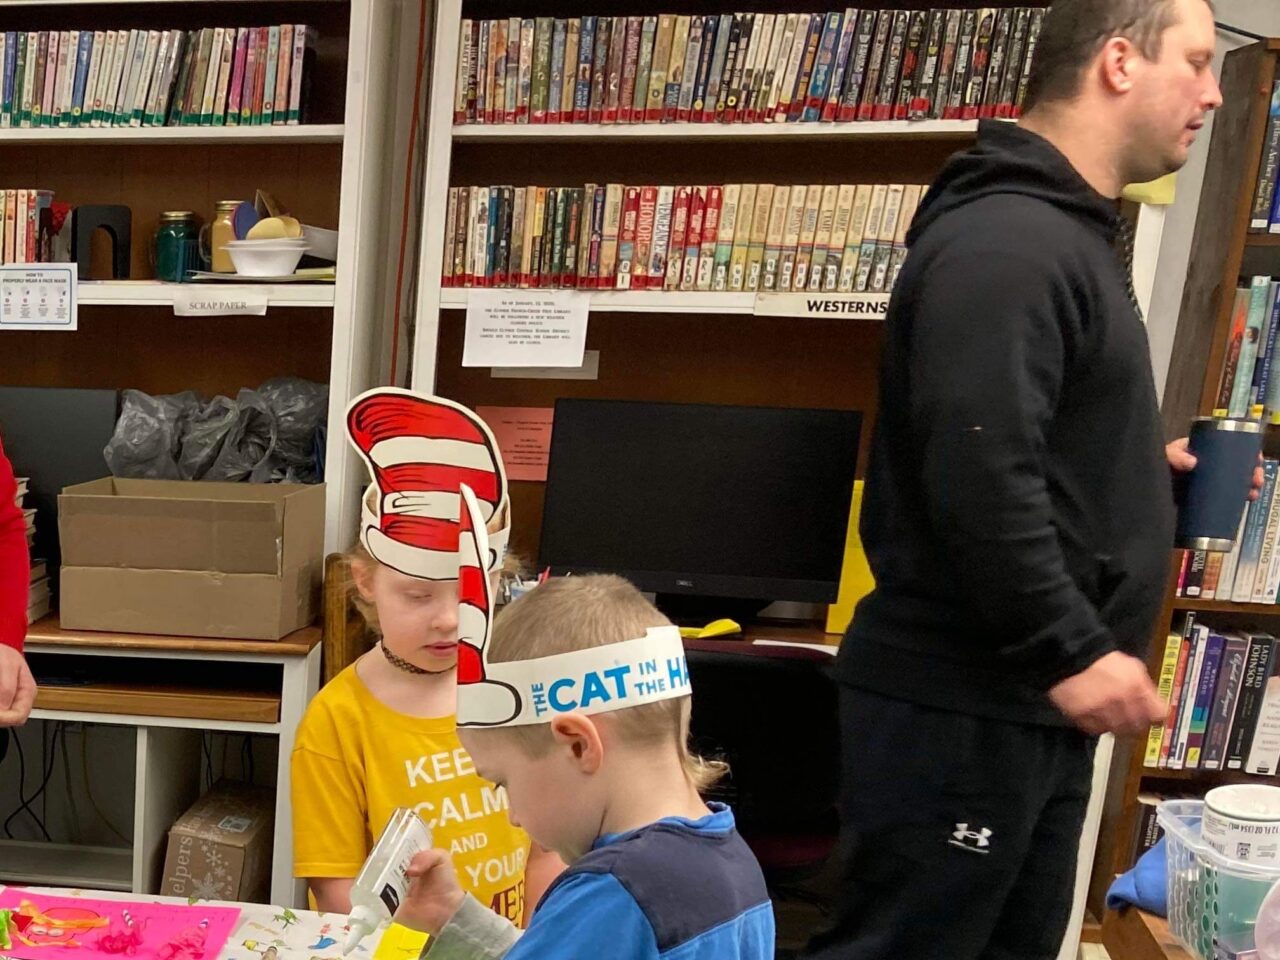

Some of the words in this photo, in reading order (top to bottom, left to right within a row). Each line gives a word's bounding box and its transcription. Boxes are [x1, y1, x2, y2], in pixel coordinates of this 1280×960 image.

[189, 302, 218, 310] SCRAP
[220, 302, 247, 310] PAPER
[807, 300, 888, 314] WESTERNS
[1261, 531, 1275, 564] LIVING
[1245, 644, 1261, 687] JOHNSON
[1259, 645, 1270, 666] LADY
[531, 682, 548, 717] THE
[548, 664, 631, 712] CAT
[638, 659, 658, 675] IN
[634, 678, 666, 696] THE
[666, 655, 691, 689] HA
[1254, 667, 1265, 688] BIRD
[404, 748, 477, 788] KEE
[414, 785, 510, 829] CALM
[450, 832, 488, 855] AND
